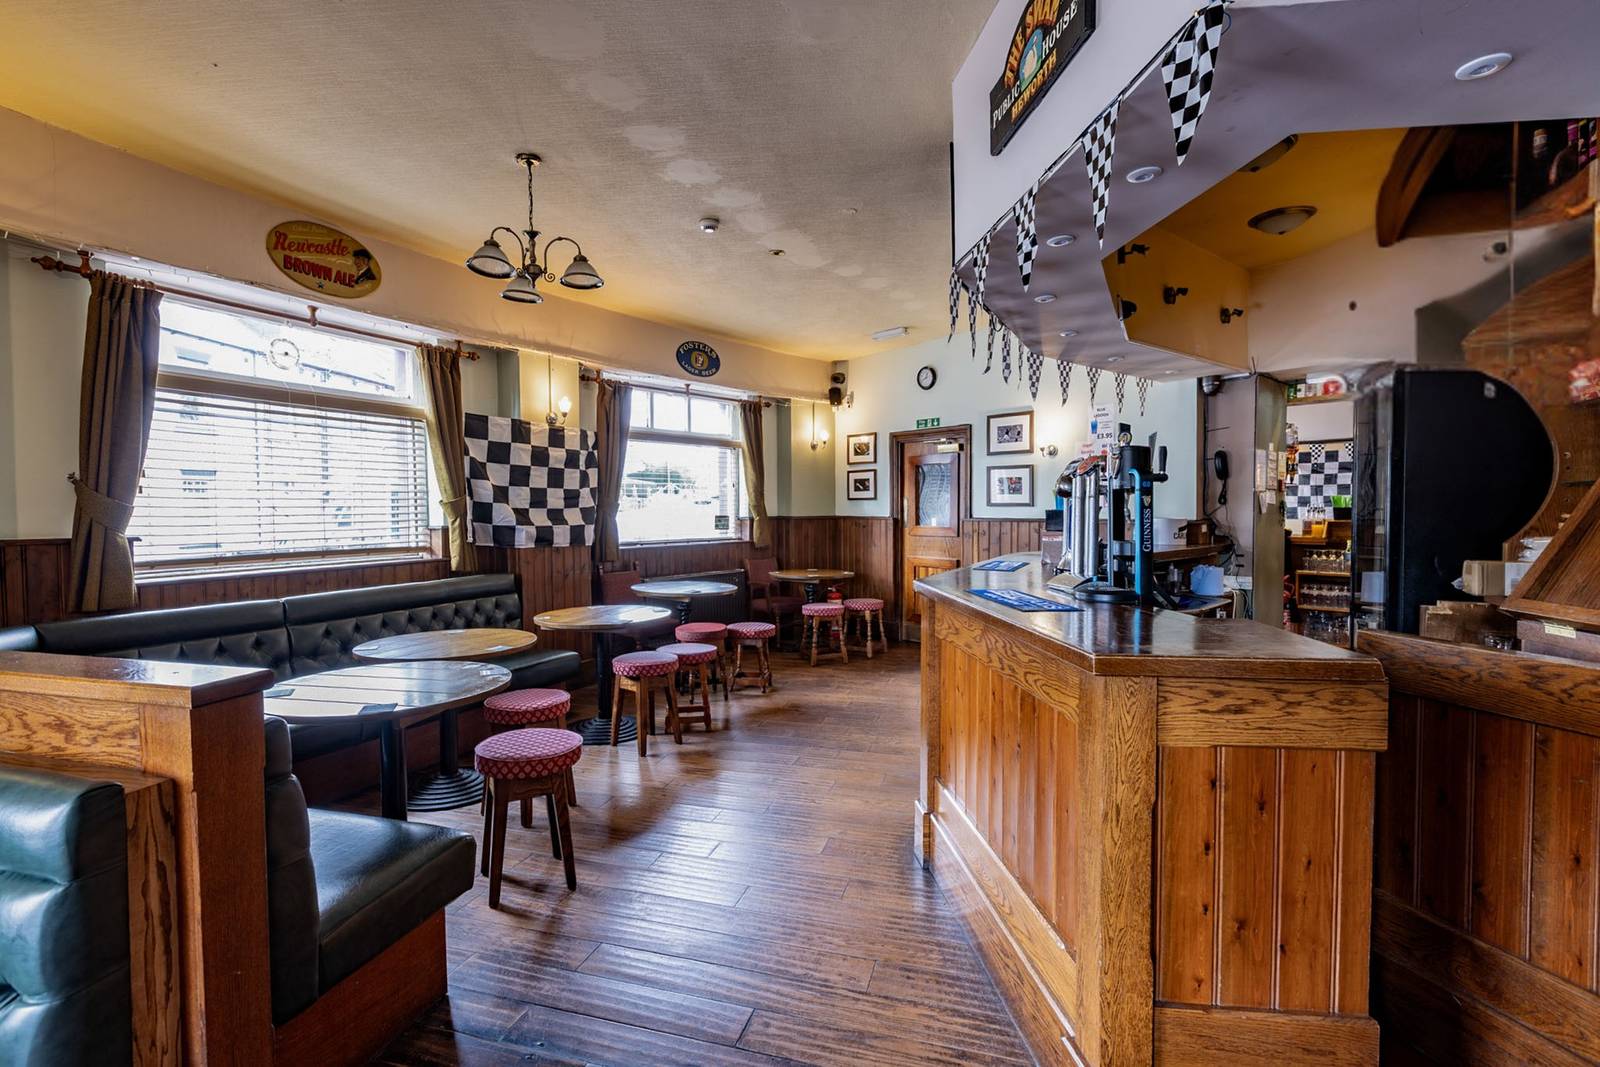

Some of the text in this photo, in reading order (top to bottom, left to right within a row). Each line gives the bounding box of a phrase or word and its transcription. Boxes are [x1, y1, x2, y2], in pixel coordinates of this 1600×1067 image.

[993, 0, 1077, 129] PUBLIC HOUSE
[1004, 27, 1025, 88] THE
[273, 231, 350, 256] Newcastle
[283, 254, 356, 288] BROWN ALE
[682, 361, 716, 376] LAGER BEER
[1142, 508, 1151, 552] GUINNESS
